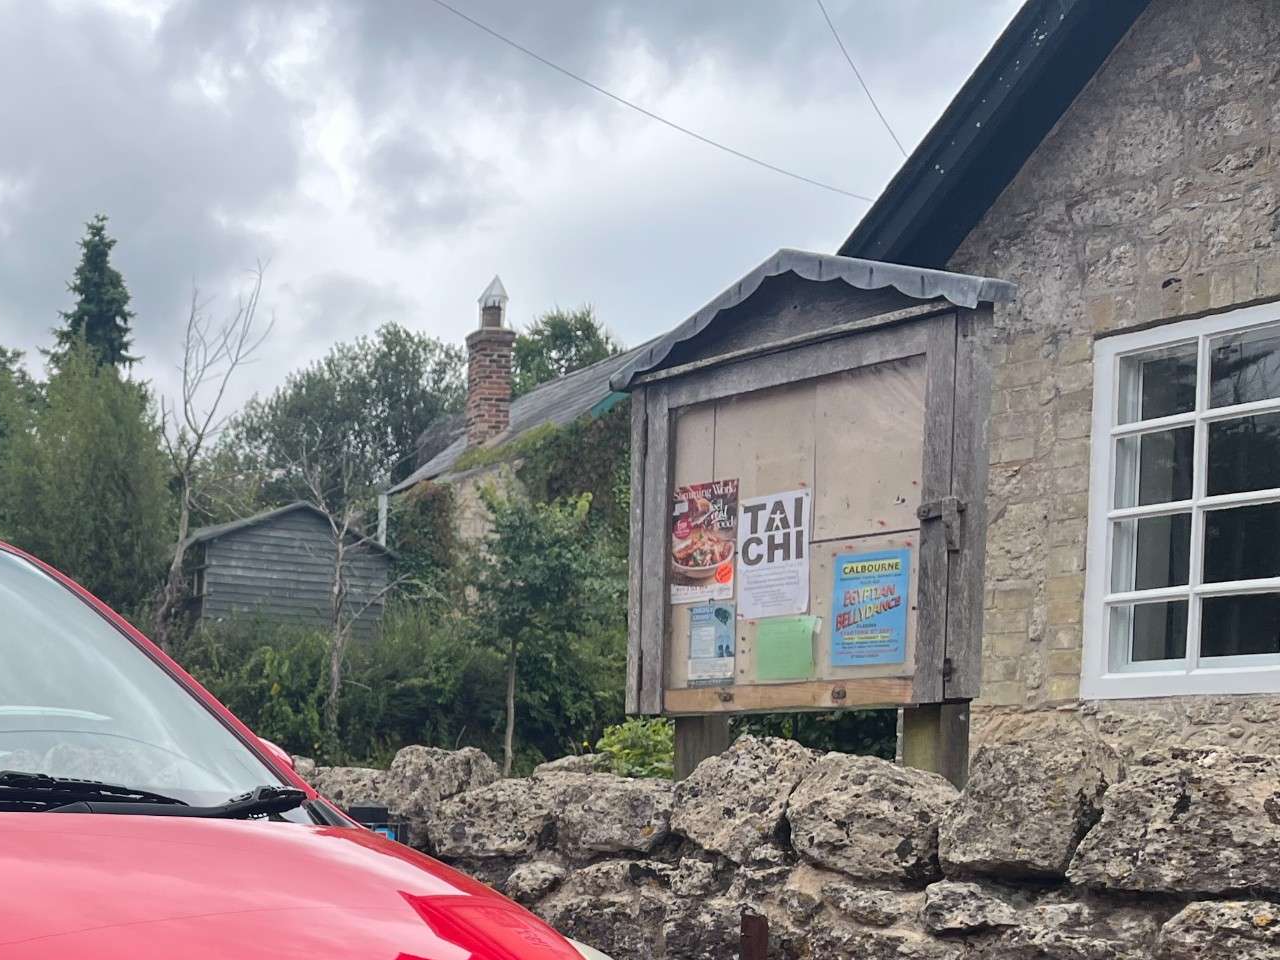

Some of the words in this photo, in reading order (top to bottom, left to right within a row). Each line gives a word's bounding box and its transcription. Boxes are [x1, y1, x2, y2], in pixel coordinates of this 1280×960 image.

[743, 496, 804, 534] TAI
[741, 529, 805, 567] CHI
[842, 561, 900, 576] CALBOURNE
[835, 596, 902, 632] BELLYDANCE
[843, 584, 896, 608] EGYPTIAN
